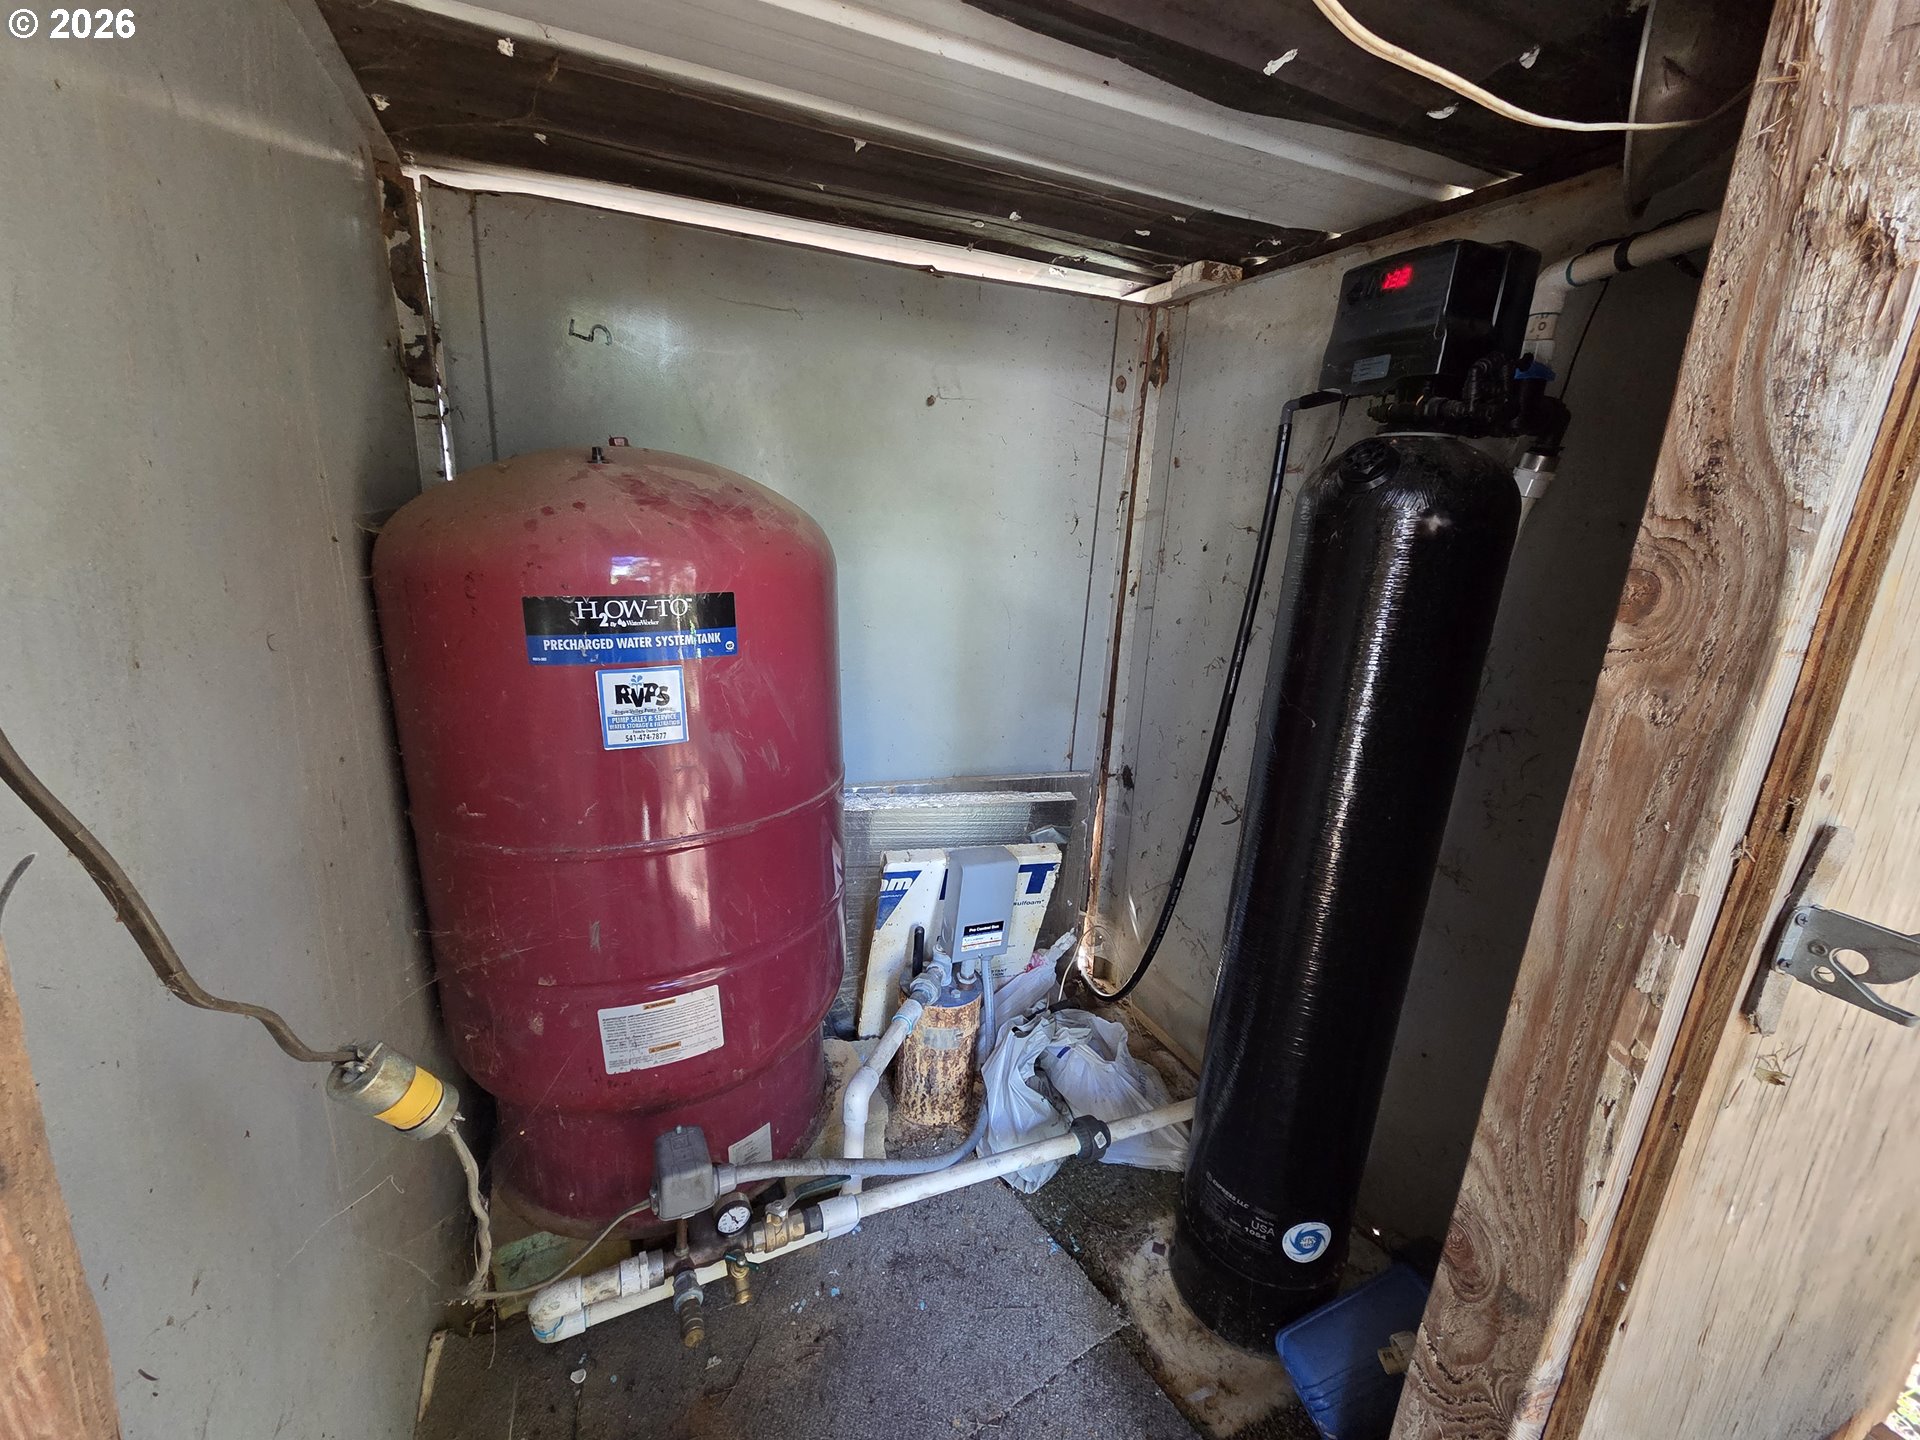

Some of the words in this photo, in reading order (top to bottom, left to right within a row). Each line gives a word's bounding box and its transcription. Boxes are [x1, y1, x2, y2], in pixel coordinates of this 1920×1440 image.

[543, 638, 614, 650] PRECHARGED
[616, 637, 652, 648] WATER
[656, 635, 694, 647] SYSTEM
[696, 632, 721, 643] TANK
[625, 732, 667, 742] 541-474-7877
[1236, 1199, 1249, 1209] LLC
[1251, 1220, 1275, 1237] USA
